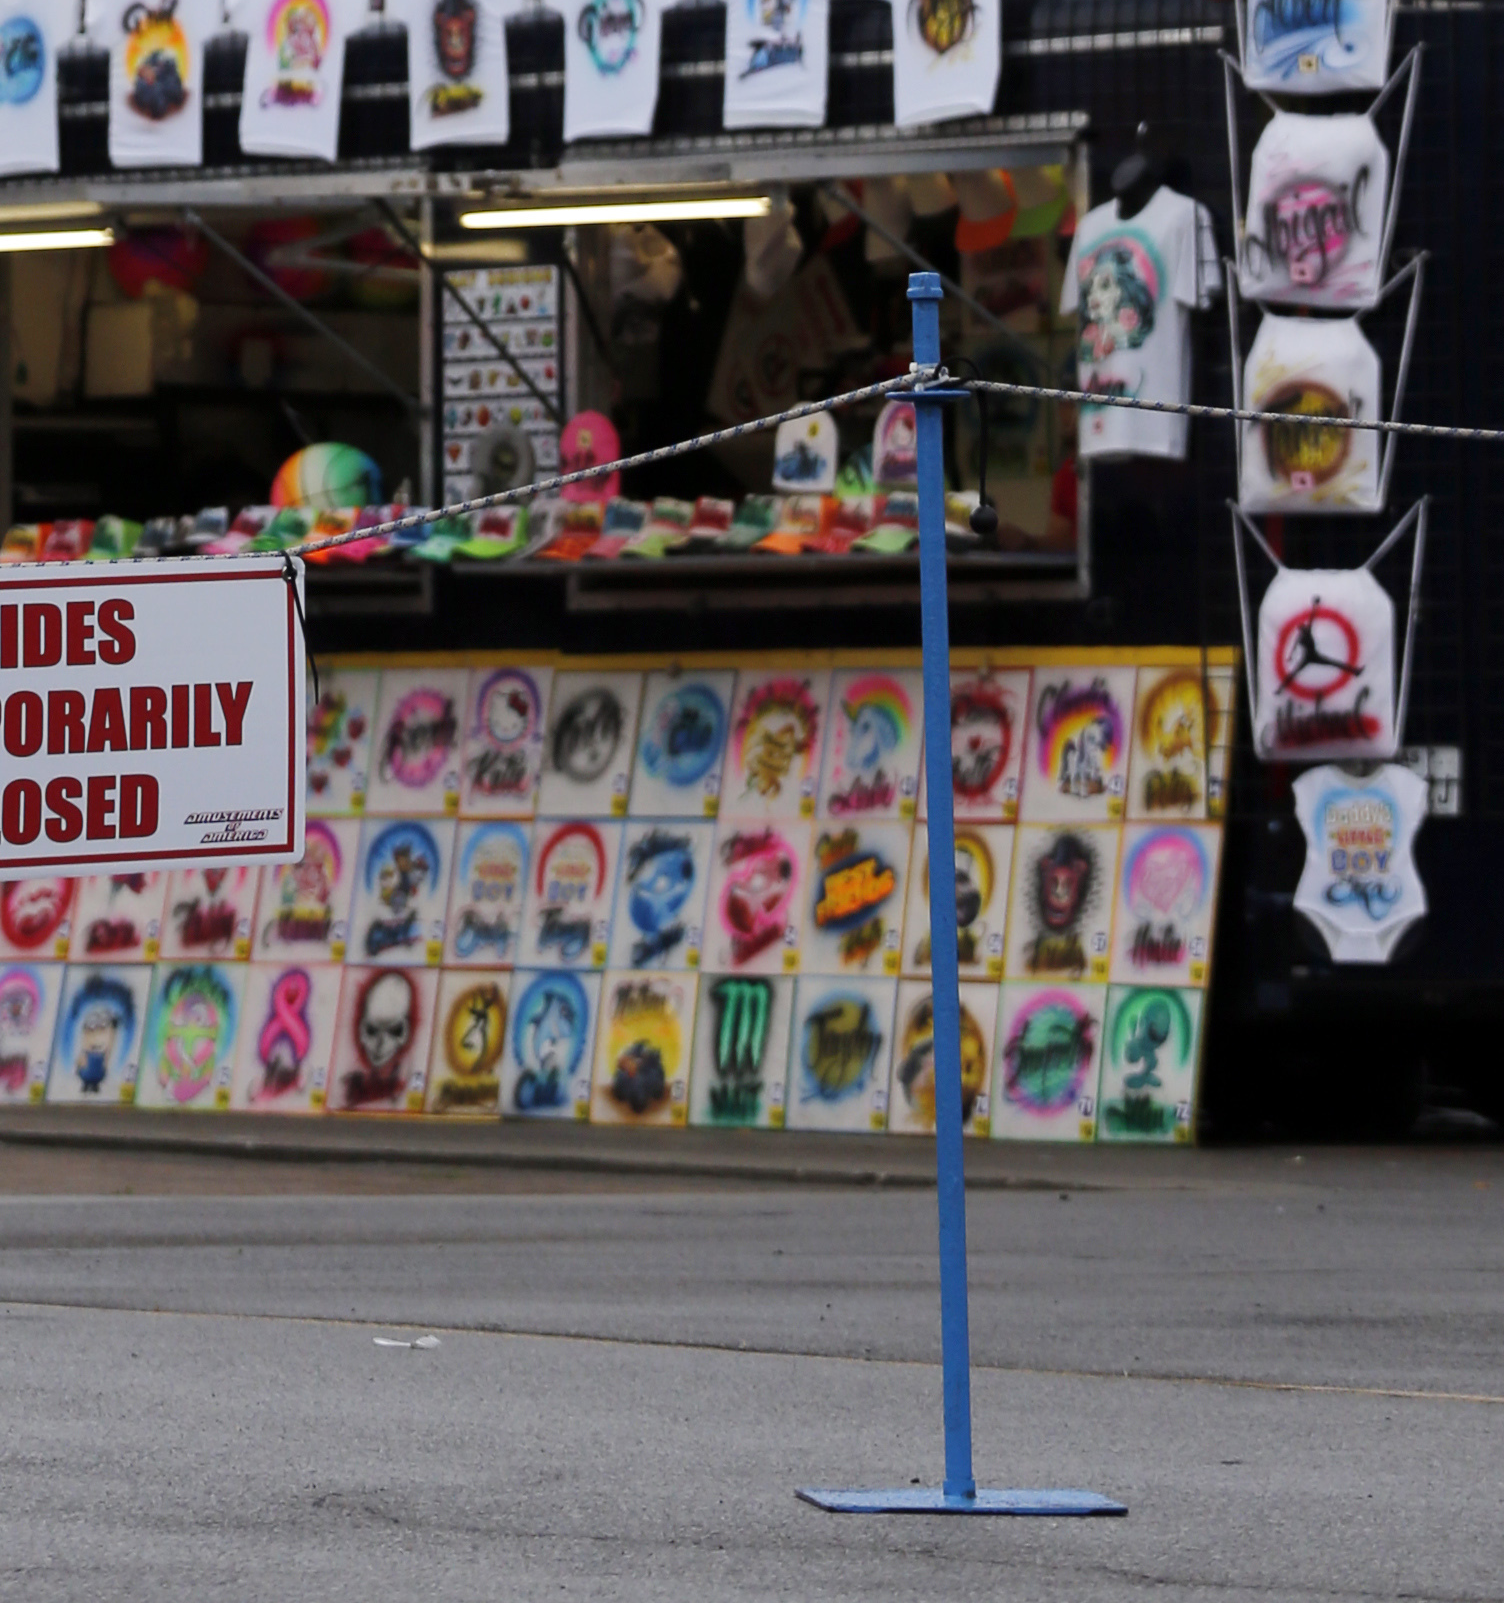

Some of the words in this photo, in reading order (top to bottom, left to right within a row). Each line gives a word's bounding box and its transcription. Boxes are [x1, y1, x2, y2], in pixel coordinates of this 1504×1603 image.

[183, 808, 285, 826] AMUSEMENTS
[200, 829, 269, 844] AMERICA
[1330, 847, 1389, 873] BOY
